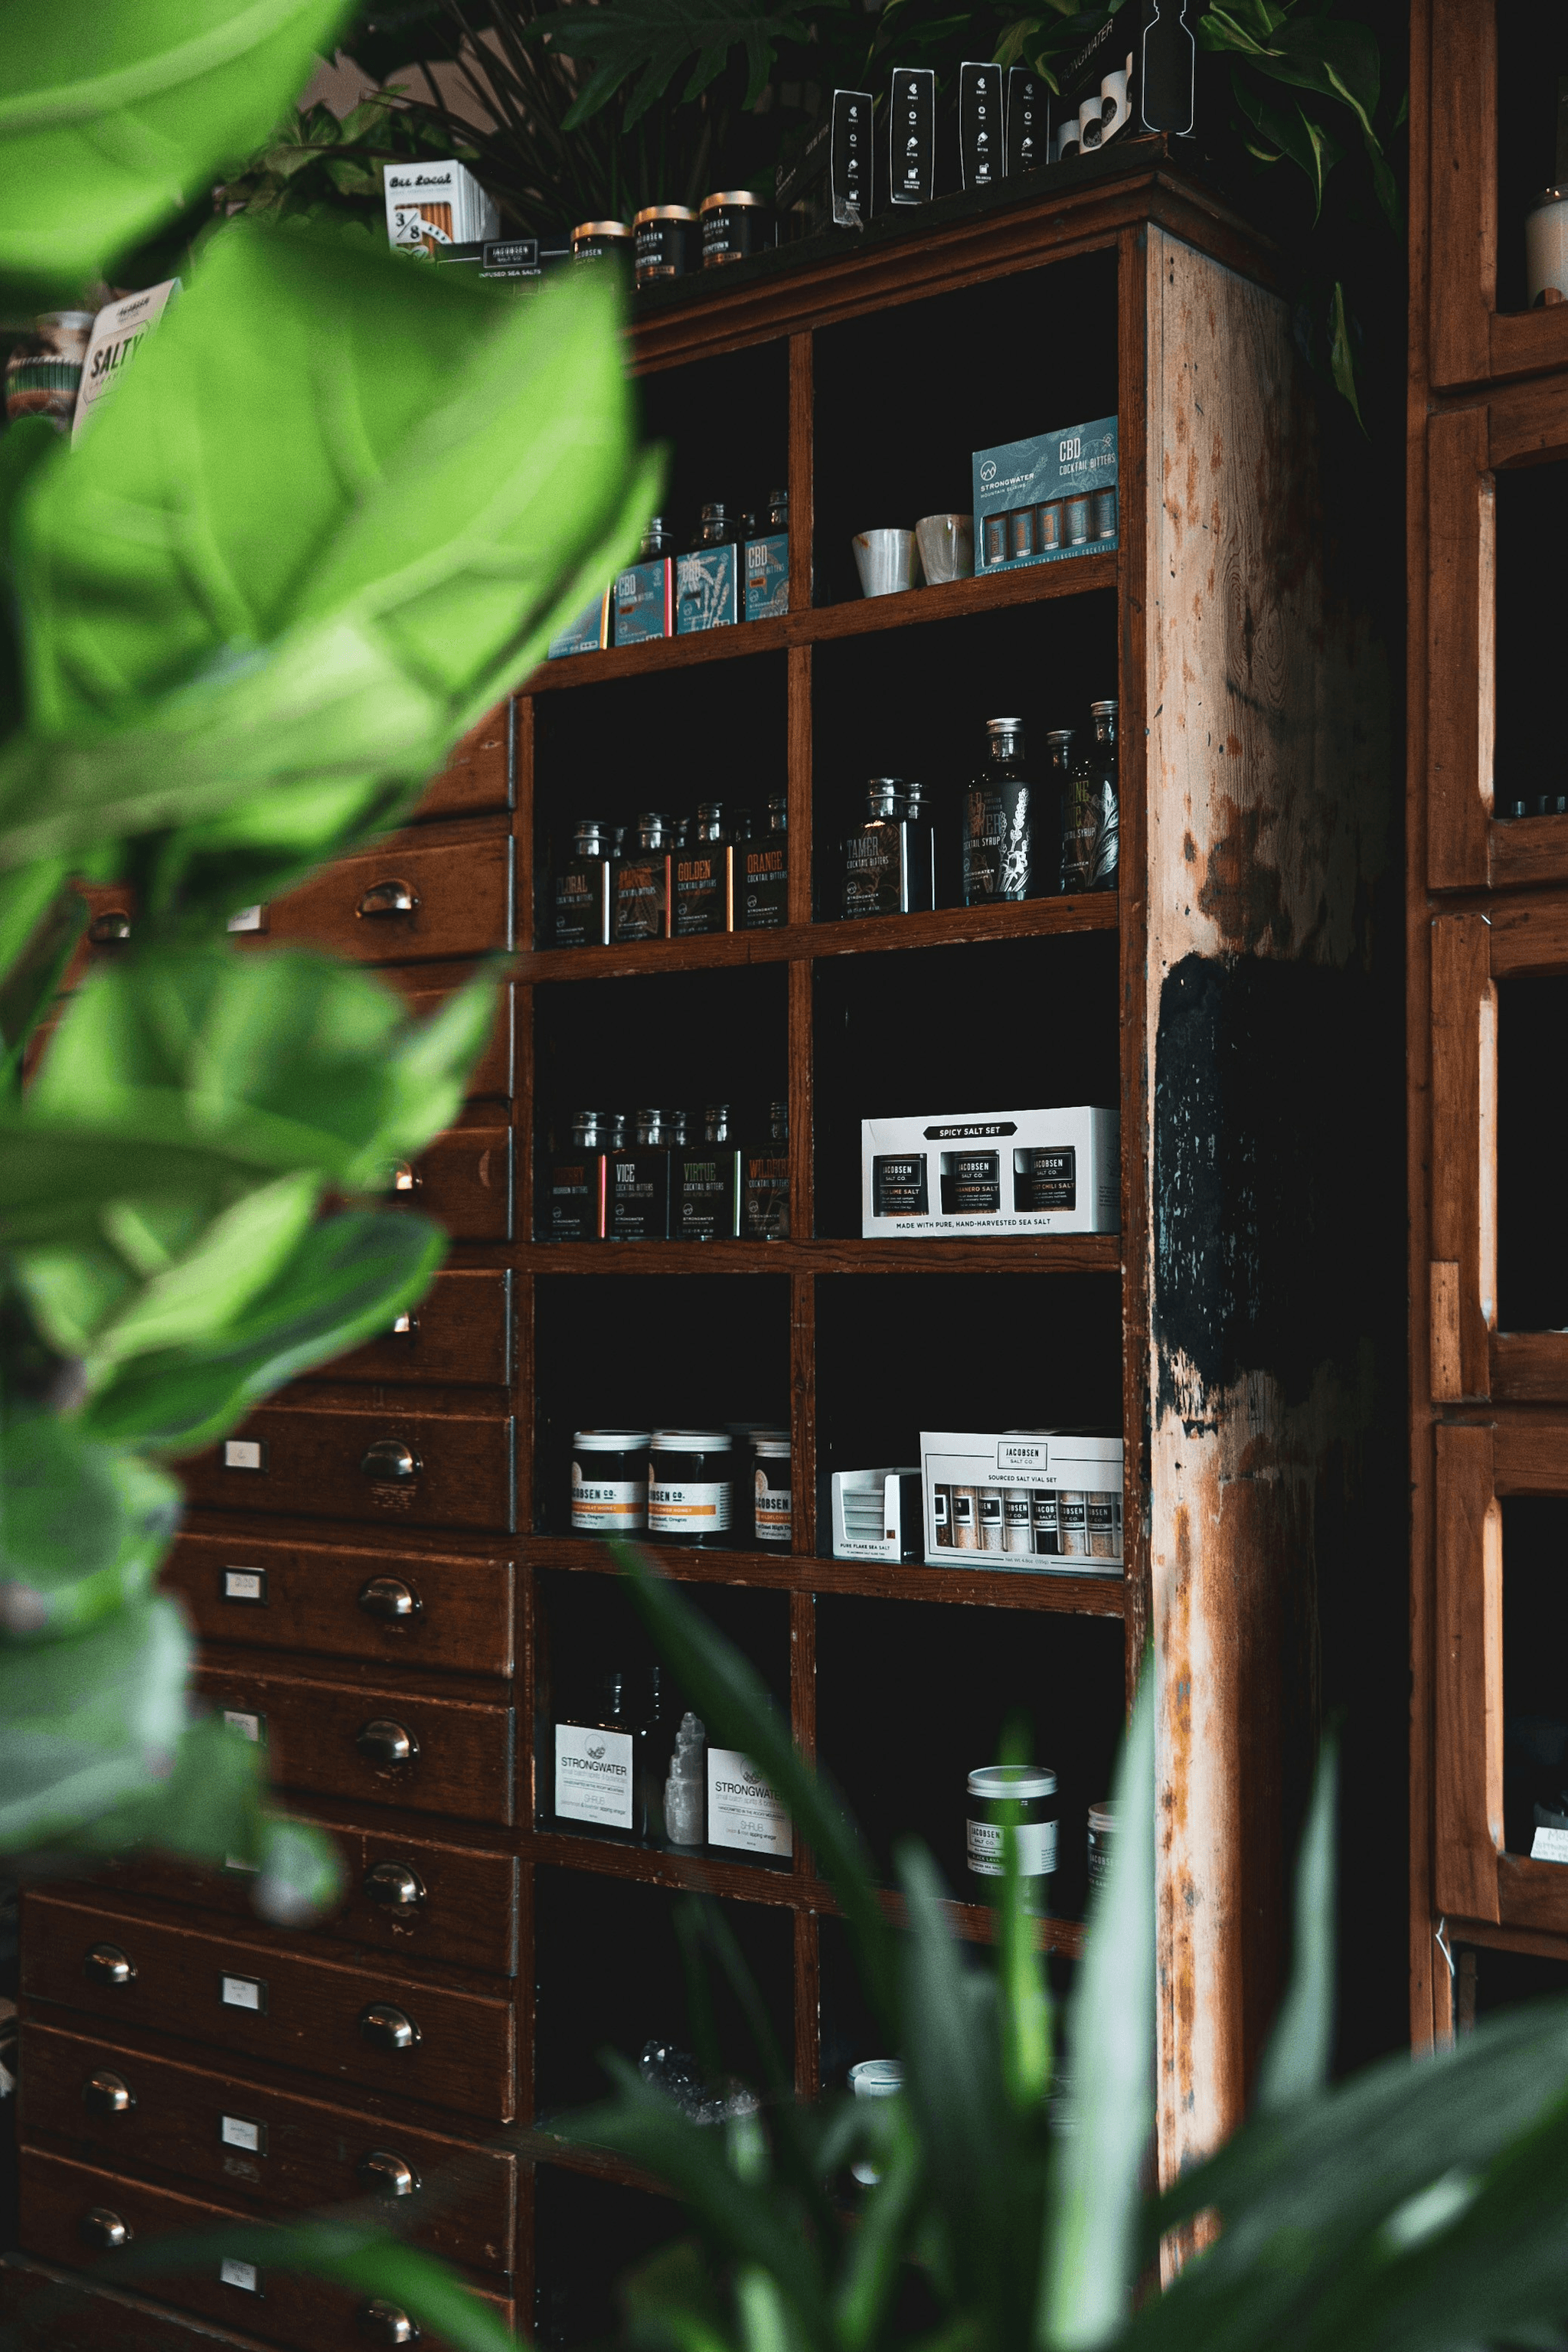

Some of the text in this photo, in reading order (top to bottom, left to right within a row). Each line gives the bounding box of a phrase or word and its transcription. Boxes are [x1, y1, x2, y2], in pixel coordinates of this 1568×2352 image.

[415, 173, 452, 185] Local
[1059, 437, 1081, 462] CBD
[1059, 453, 1116, 475] COCKTAIL BITTERS
[980, 472, 1034, 492] STRONGWATER
[749, 544, 767, 568] CBD
[619, 573, 635, 597] CBD
[1077, 827, 1096, 838] SYRUP
[982, 836, 1001, 847] SYRUP
[747, 851, 782, 874] ORANGE
[847, 856, 889, 869] COCKTAIL BITTERS
[678, 859, 711, 881] GOLDEN
[747, 871, 788, 883] COCKTAIL BITTERS
[939, 1129, 962, 1137] SPICY
[985, 1126, 1000, 1135] SET
[883, 1165, 911, 1174] JACOBSEN
[959, 1162, 989, 1171] JACOBSEN
[1034, 1159, 1063, 1168] JACOBSEN
[616, 1164, 635, 1182] VICE
[684, 1162, 716, 1181] VIRTUE
[683, 1182, 724, 1191] COCKTAIL BITTERS
[1006, 1449, 1039, 1457] JACOBSEN
[561, 1756, 627, 1776] STRONGWATER
[715, 1781, 781, 1801] STRONGWATE
[971, 1827, 1000, 1839] JACOBSEN
